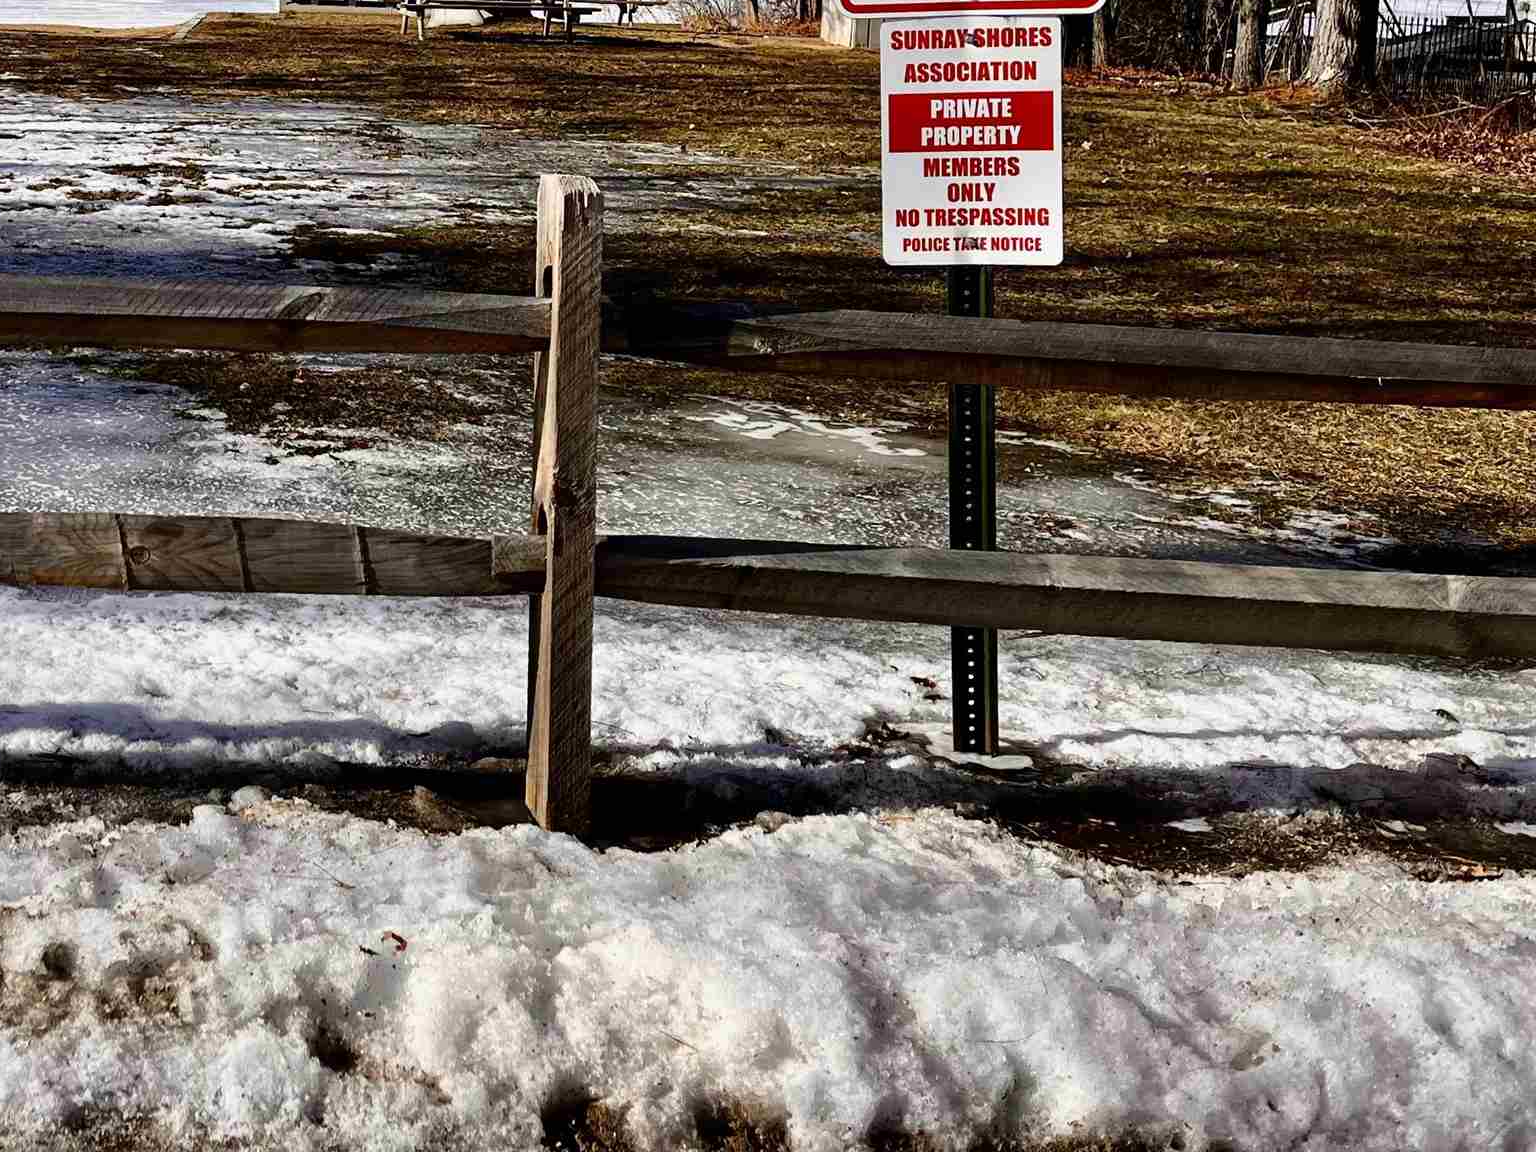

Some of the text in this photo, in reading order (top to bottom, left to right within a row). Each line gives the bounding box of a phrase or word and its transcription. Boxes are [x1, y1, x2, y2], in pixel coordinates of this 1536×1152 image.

[891, 27, 1052, 50] SUNRAY SHORES
[904, 61, 1037, 83] ASSOCIATION
[930, 98, 1012, 119] PRIVATE
[921, 126, 1022, 146] PROPERTY
[923, 157, 1020, 177] MEMBERS
[947, 183, 996, 202] ONLY
[896, 208, 1049, 227] NO TRESPASSING
[903, 238, 950, 252] POLICE
[991, 237, 1042, 251] NOTICE
